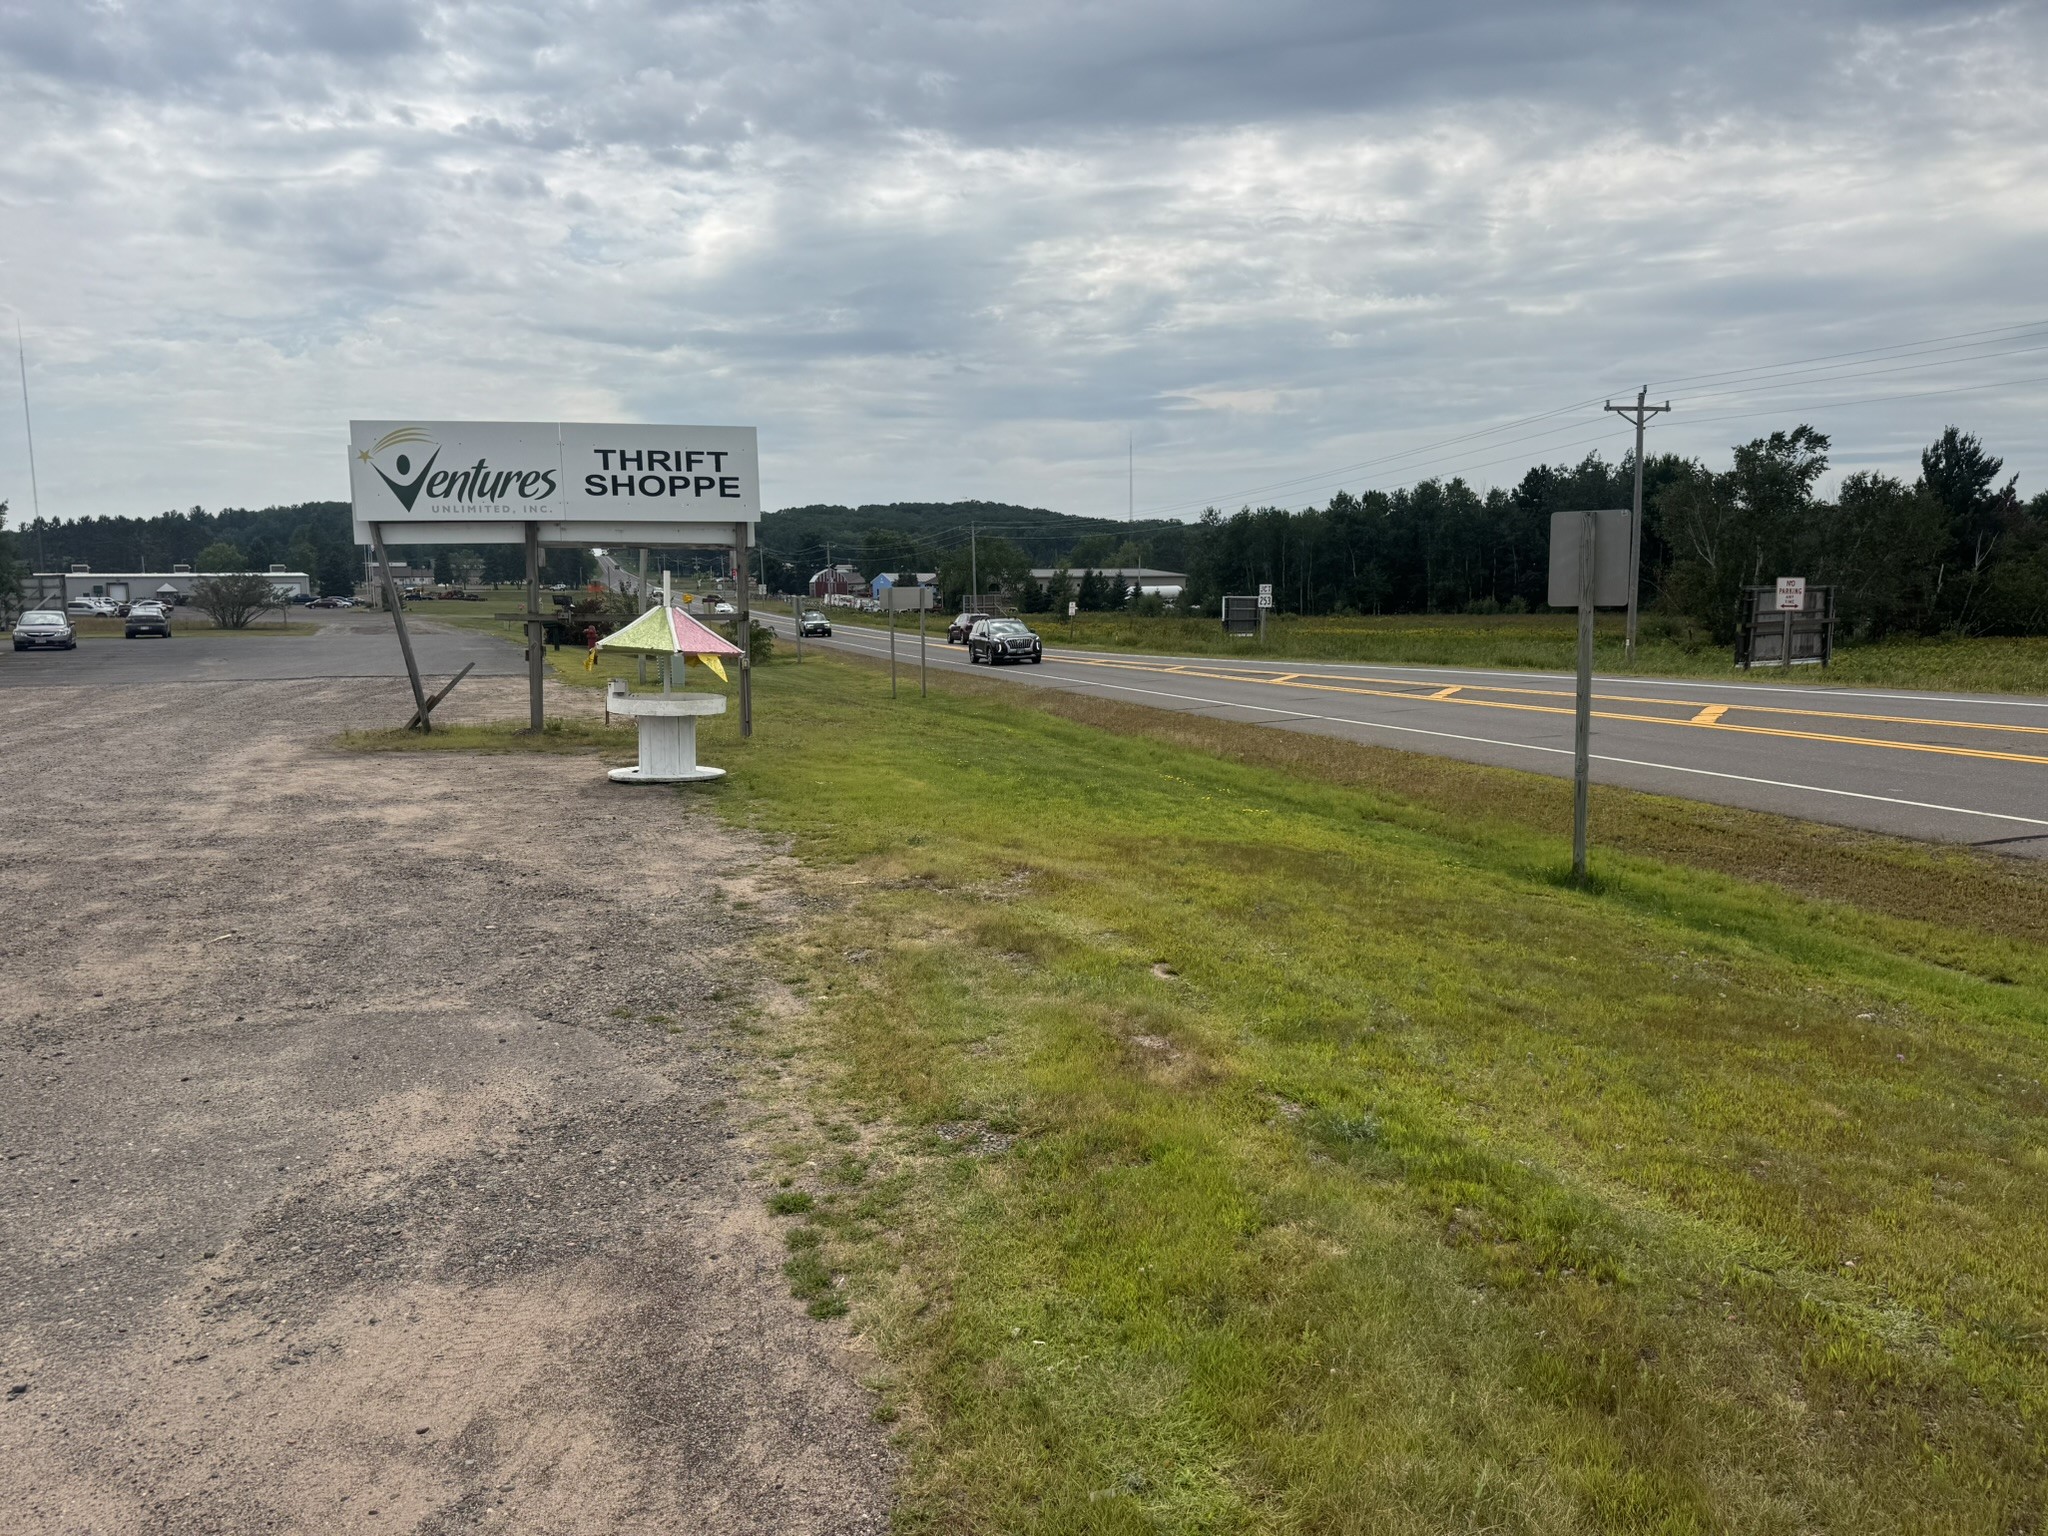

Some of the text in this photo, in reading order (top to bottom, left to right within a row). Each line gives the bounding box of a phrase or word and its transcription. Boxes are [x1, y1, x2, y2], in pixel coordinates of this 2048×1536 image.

[593, 449, 729, 473] THRIFT
[370, 444, 557, 513] Ventures
[584, 474, 741, 498] SHOPPE
[431, 504, 553, 514] UNLIMITED, INC.
